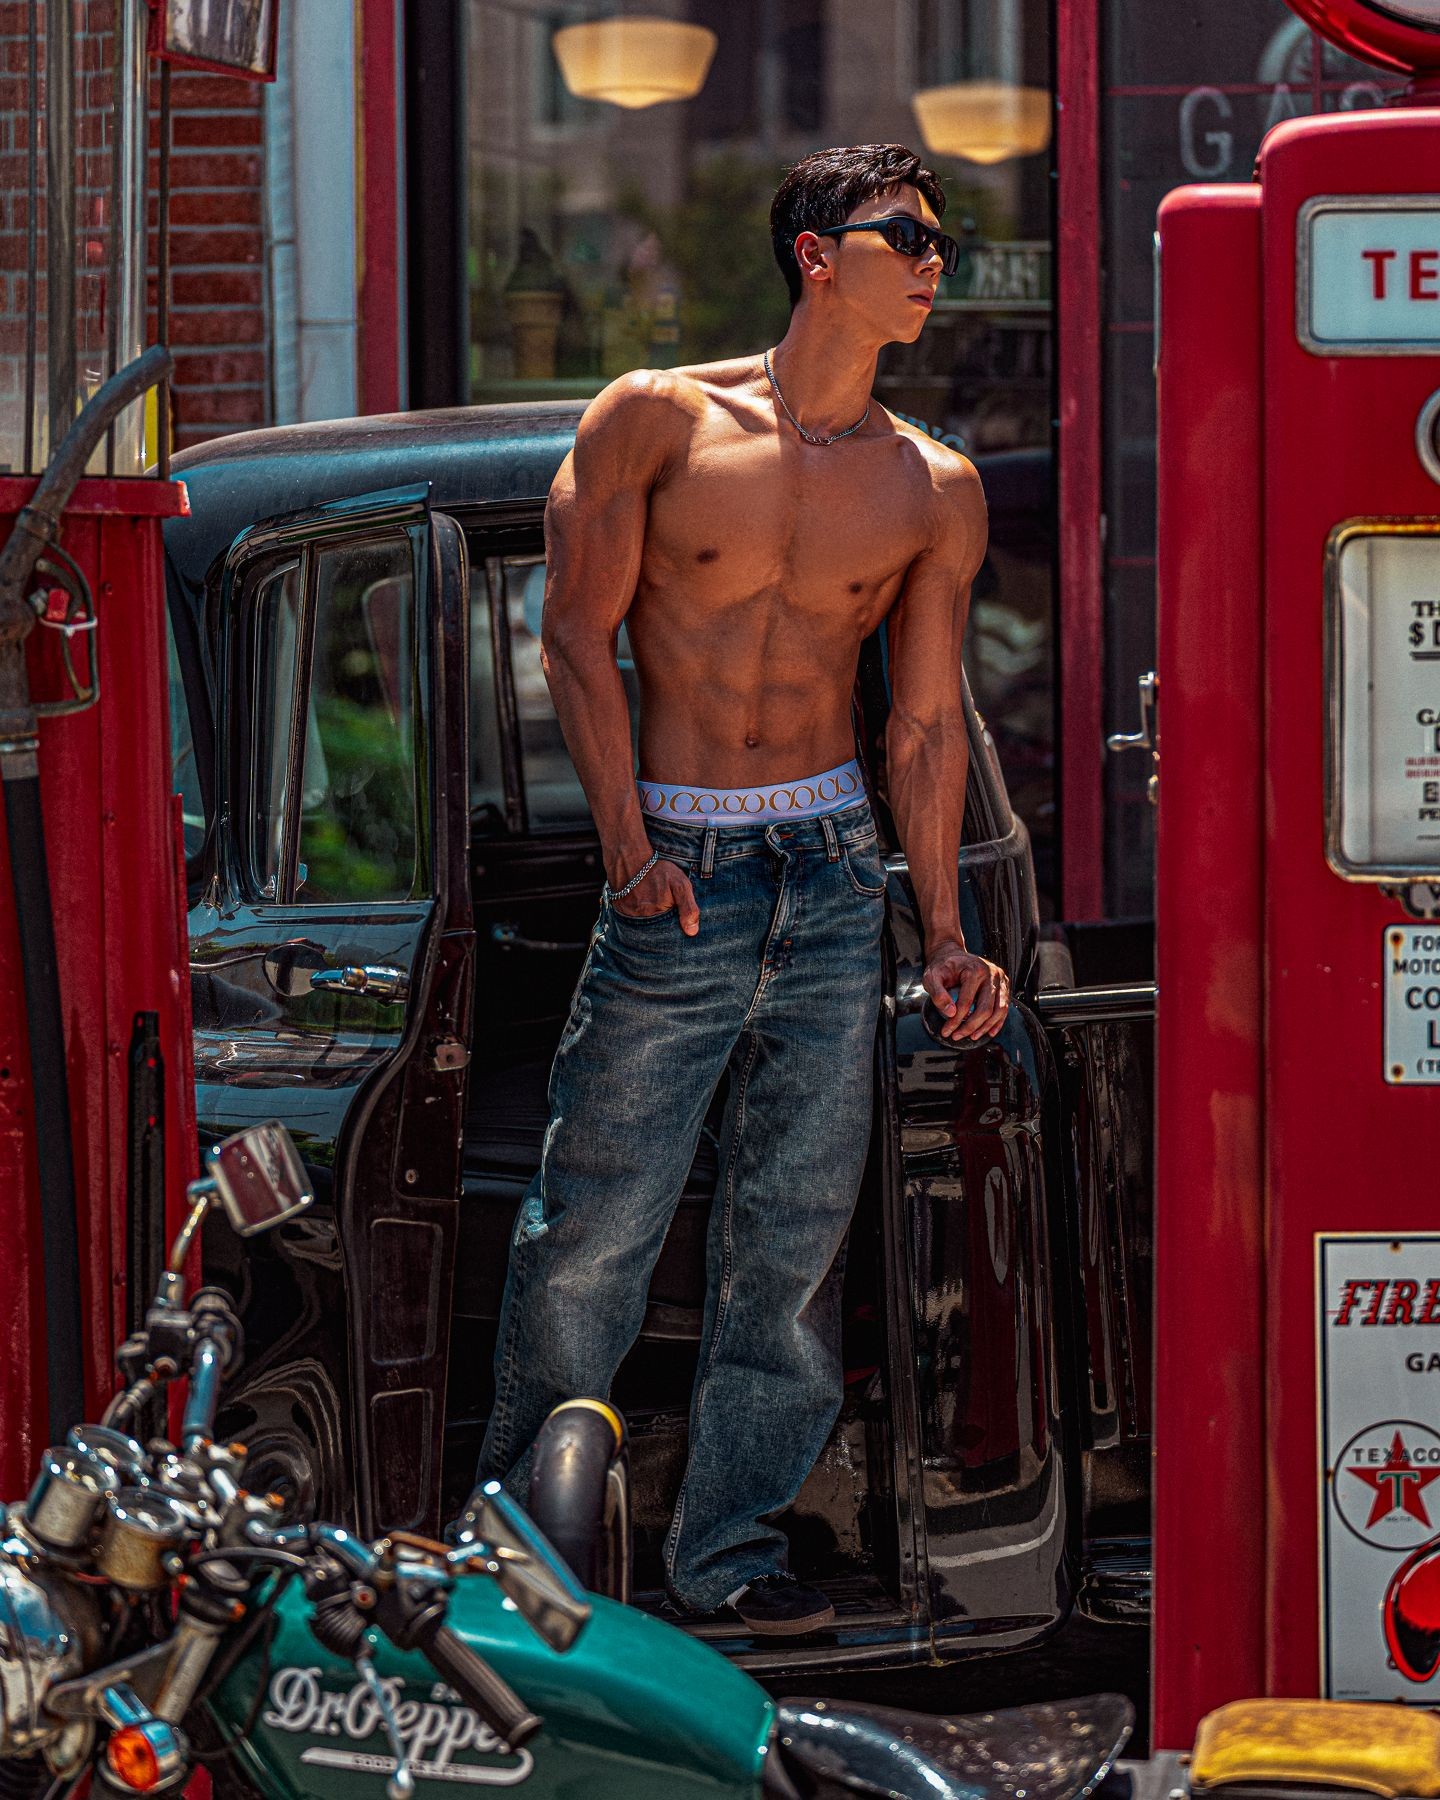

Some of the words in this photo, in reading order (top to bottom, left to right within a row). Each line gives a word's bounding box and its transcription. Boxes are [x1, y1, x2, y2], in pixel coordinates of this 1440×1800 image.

[1361, 249, 1440, 300] TE
[1405, 986, 1440, 1010] CO
[1352, 1447, 1440, 1463] TEXACO
